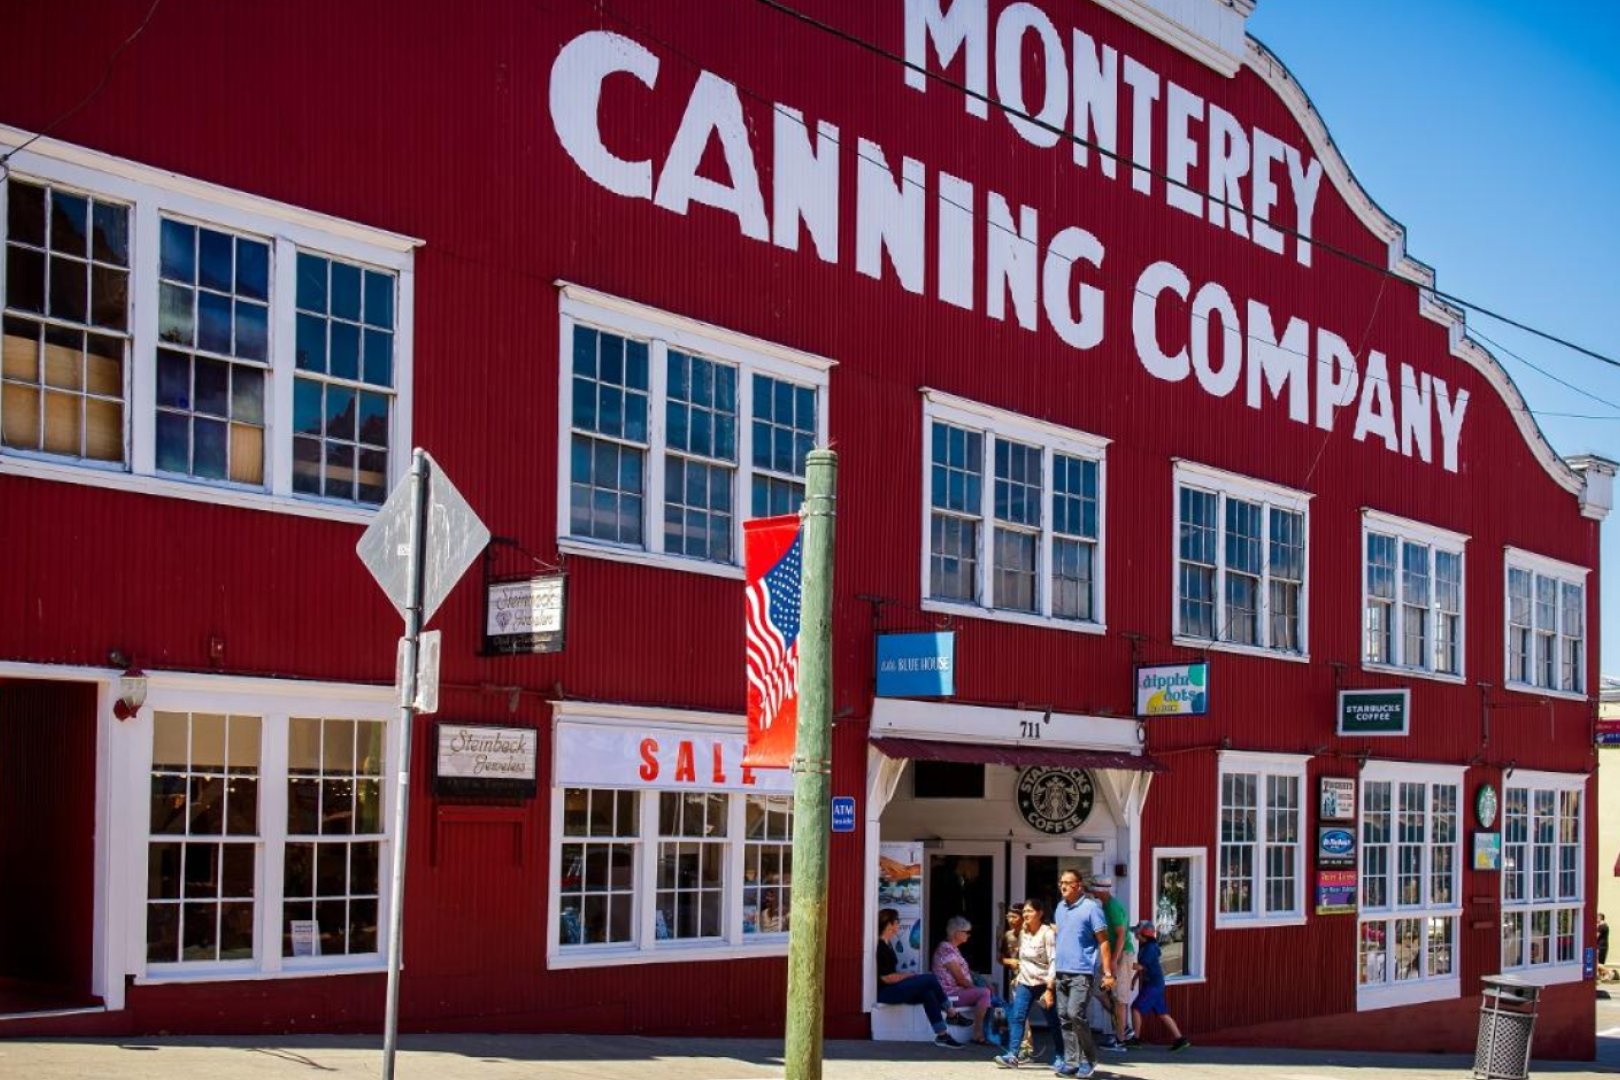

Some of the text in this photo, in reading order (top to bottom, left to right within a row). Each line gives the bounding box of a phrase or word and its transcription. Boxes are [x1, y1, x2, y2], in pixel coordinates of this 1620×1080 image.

[904, 0, 1322, 268] MONTEREY
[549, 30, 1470, 474] CANNING COMPANY
[898, 657, 920, 671] BLUE
[921, 656, 950, 671] HOUSE
[1346, 704, 1402, 713] STARBUCKS
[1356, 712, 1391, 721] COFFEE
[1020, 721, 1040, 739] 711
[450, 729, 527, 754] Steinbeck
[834, 805, 853, 815] ATM
[1028, 812, 1082, 834] COFFEE
